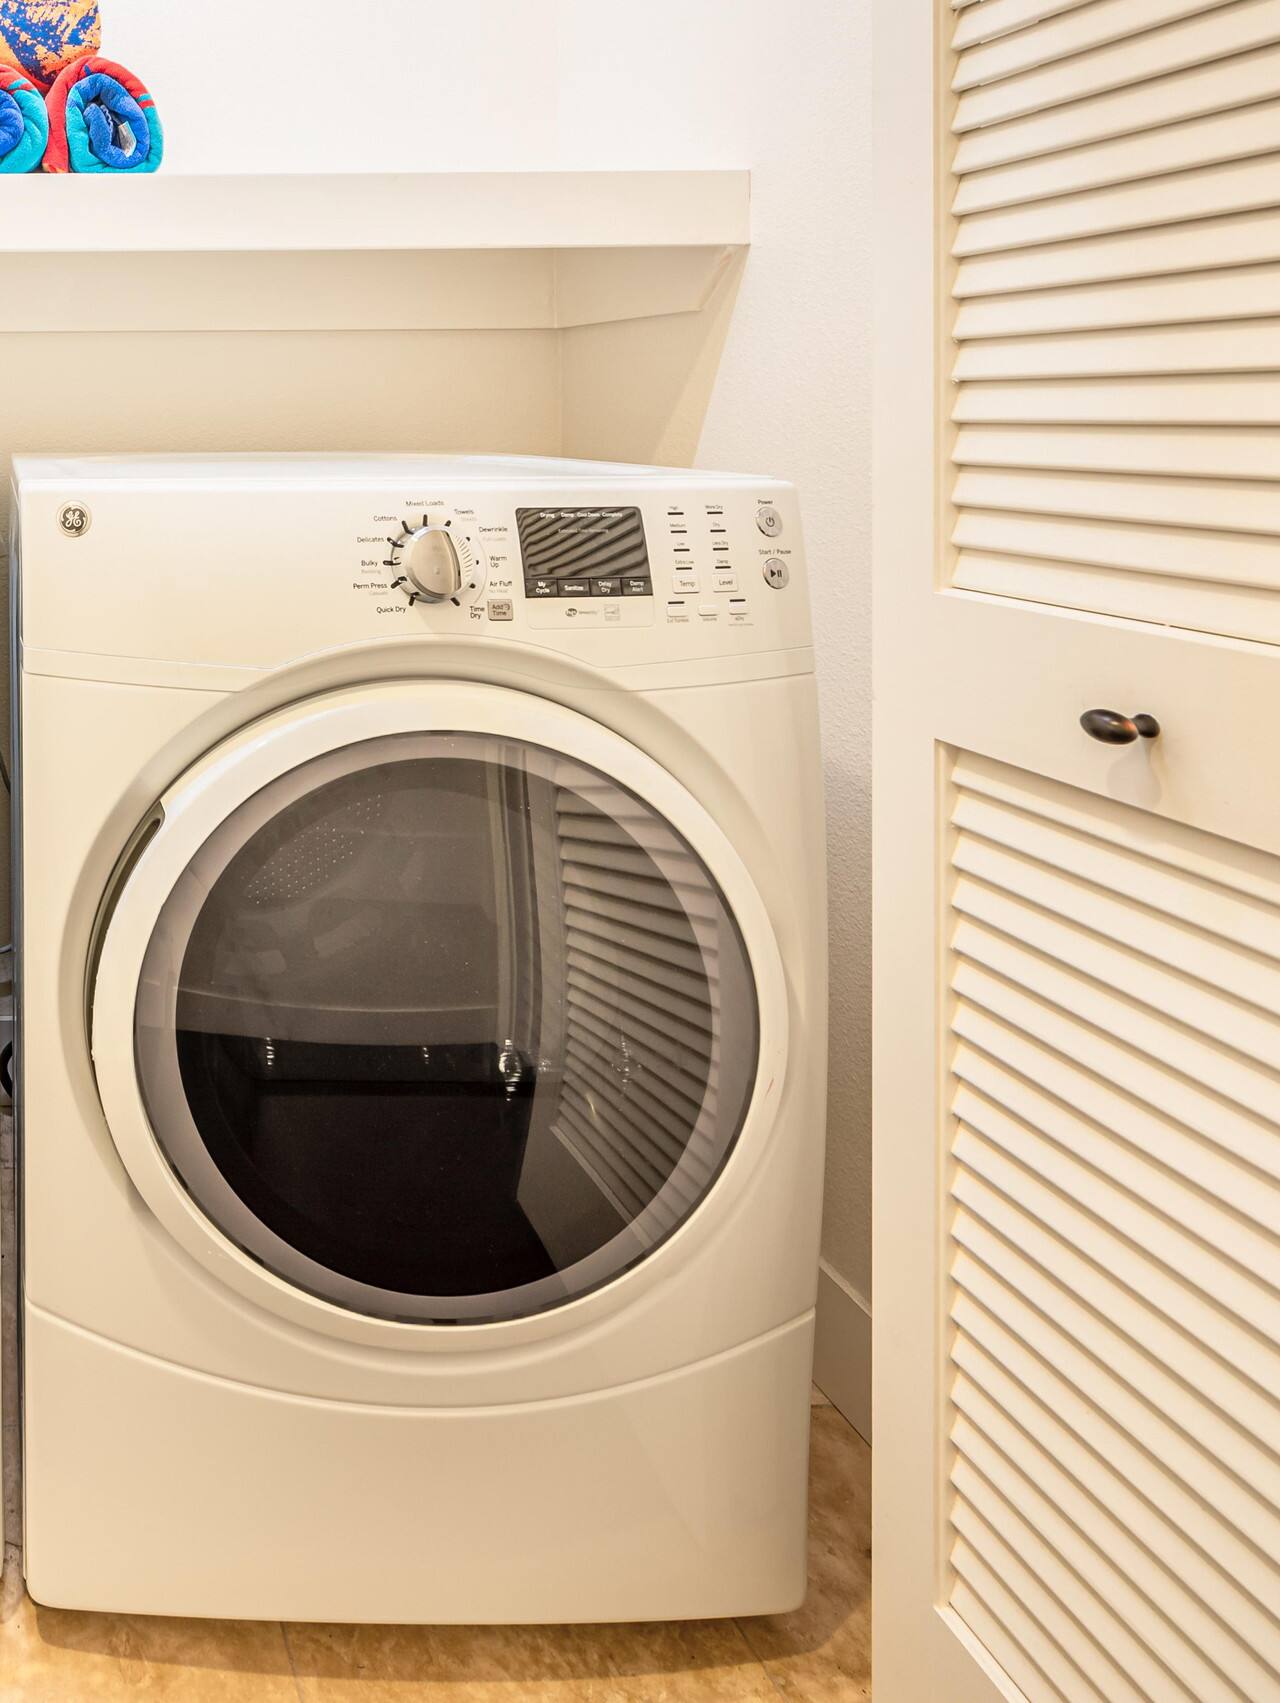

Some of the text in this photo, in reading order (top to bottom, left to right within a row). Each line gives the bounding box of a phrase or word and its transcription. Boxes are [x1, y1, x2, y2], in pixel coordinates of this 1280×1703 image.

[679, 580, 696, 588] Temp
[376, 606, 406, 614] Quick Dry
[470, 612, 481, 620] Dry
